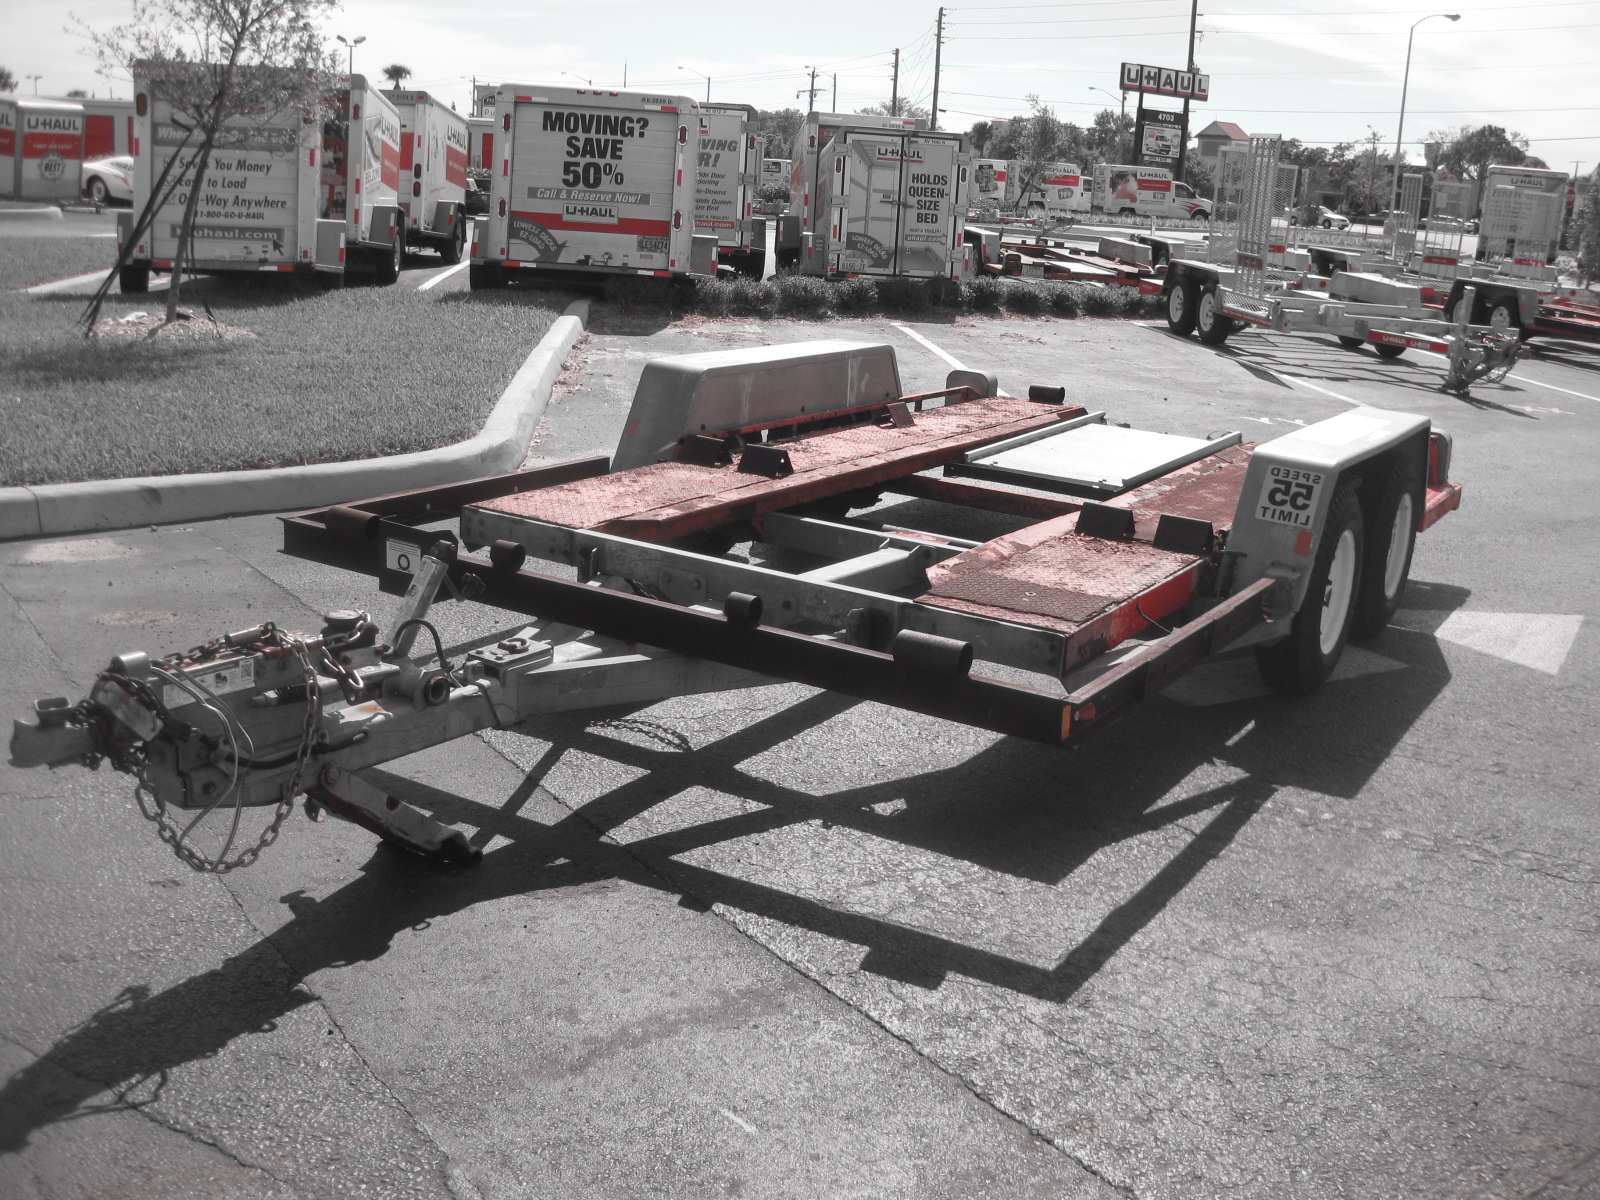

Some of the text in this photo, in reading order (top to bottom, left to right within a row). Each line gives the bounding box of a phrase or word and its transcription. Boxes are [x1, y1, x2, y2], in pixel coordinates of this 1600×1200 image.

[27, 117, 80, 131] U-HAUL
[542, 110, 649, 138] MOVING?
[1158, 113, 1175, 122] 4703
[566, 135, 624, 160] SAVE
[699, 138, 738, 152] VING
[877, 147, 923, 159] U-HAUL
[214, 158, 232, 171] You
[235, 159, 272, 176] Money
[562, 160, 624, 189] 50%
[911, 173, 948, 186] HOLDS
[207, 178, 218, 188] to
[221, 177, 247, 189] Load
[697, 179, 720, 187] pening
[1510, 178, 1544, 187] U-HAUL
[537, 188, 641, 204] Call & Reserve Now!
[908, 186, 949, 198] QUEEN-
[232, 195, 287, 211] Anywhere
[706, 204, 720, 212] Bed
[916, 199, 940, 211] SIZE
[565, 205, 616, 218] U-HAUL
[916, 212, 938, 224] BED
[696, 221, 732, 229] haul.com
[513, 220, 558, 252] LOWEST DECKS
[520, 230, 545, 250] EZ-LOAD
[852, 235, 874, 246] LOWEST
